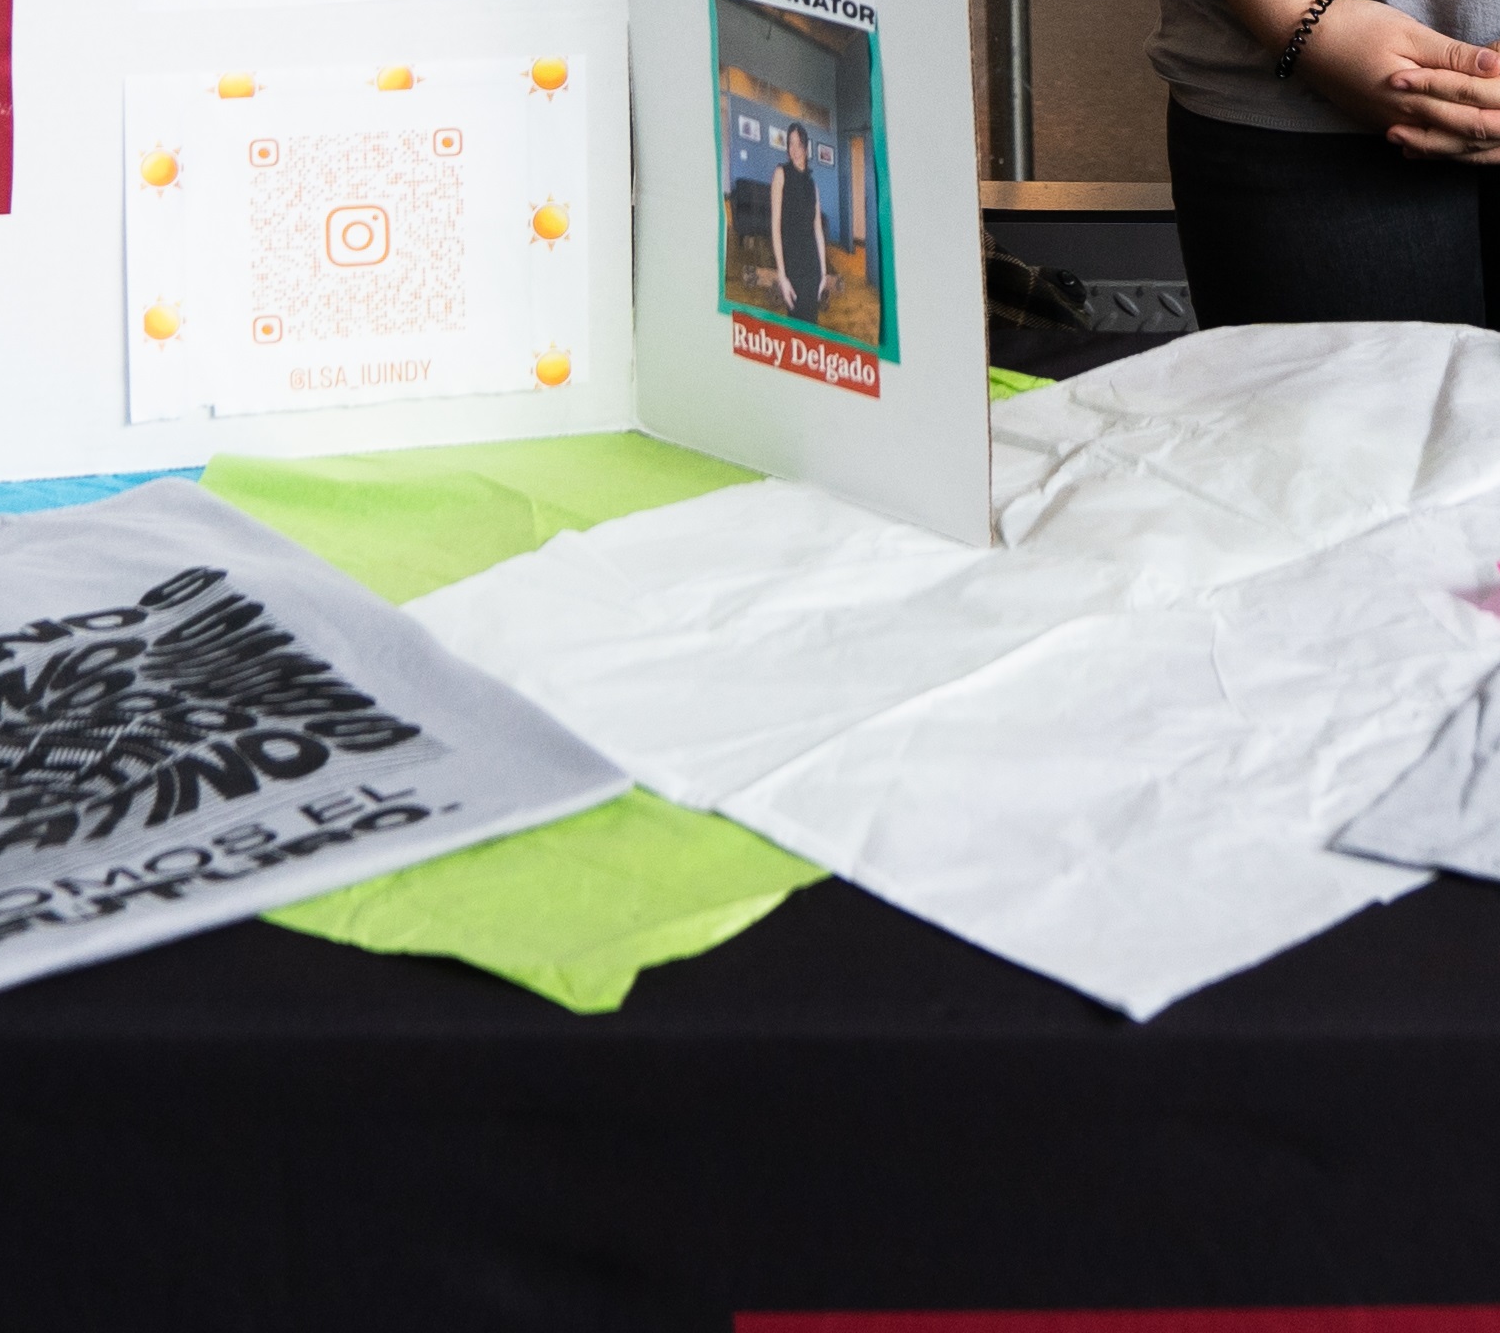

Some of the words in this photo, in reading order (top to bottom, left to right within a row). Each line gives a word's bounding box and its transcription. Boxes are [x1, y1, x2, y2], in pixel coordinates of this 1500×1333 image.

[289, 359, 433, 391] @LSA_IUINDY
[733, 323, 785, 364] Ruby
[791, 339, 876, 385] Delgado
[302, 782, 418, 827] EL
